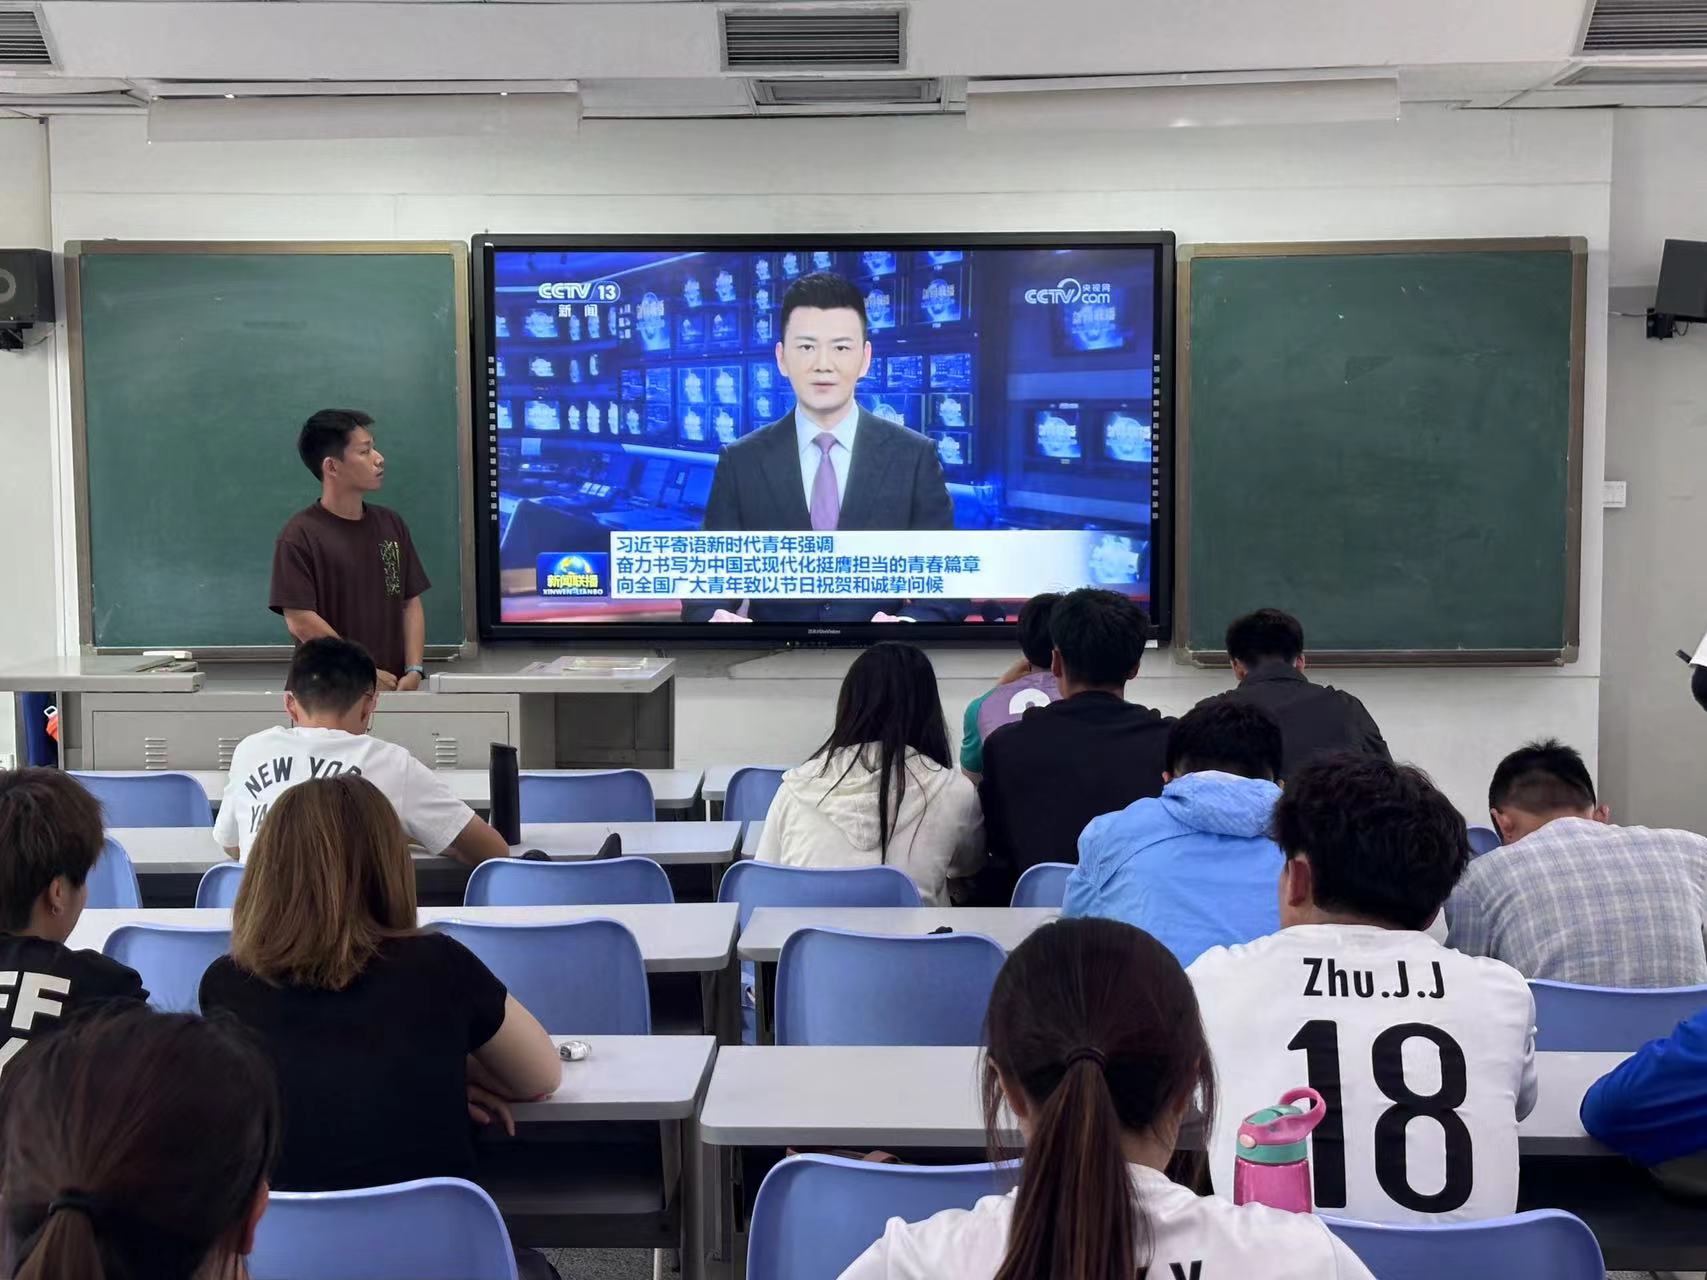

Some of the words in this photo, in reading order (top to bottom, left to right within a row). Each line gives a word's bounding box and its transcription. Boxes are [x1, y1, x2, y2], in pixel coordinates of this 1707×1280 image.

[538, 282, 592, 299] CCTV
[598, 284, 616, 301] 13
[1025, 286, 1077, 304] CCTV
[1082, 293, 1111, 304] com
[1082, 283, 1111, 292] 央视网
[558, 304, 598, 317] 新闻
[616, 536, 834, 554] 习近平寄语新时代青年强调
[616, 556, 981, 574] 奋力书写为中国式现代化挺膺担当的青春篇章
[616, 576, 944, 594] 向全国广大青年致以节日祝贺和诚挚问候
[245, 756, 293, 799] NEW
[1303, 957, 1445, 999] Zhu.J.J
[1287, 1019, 1473, 1213] 18
